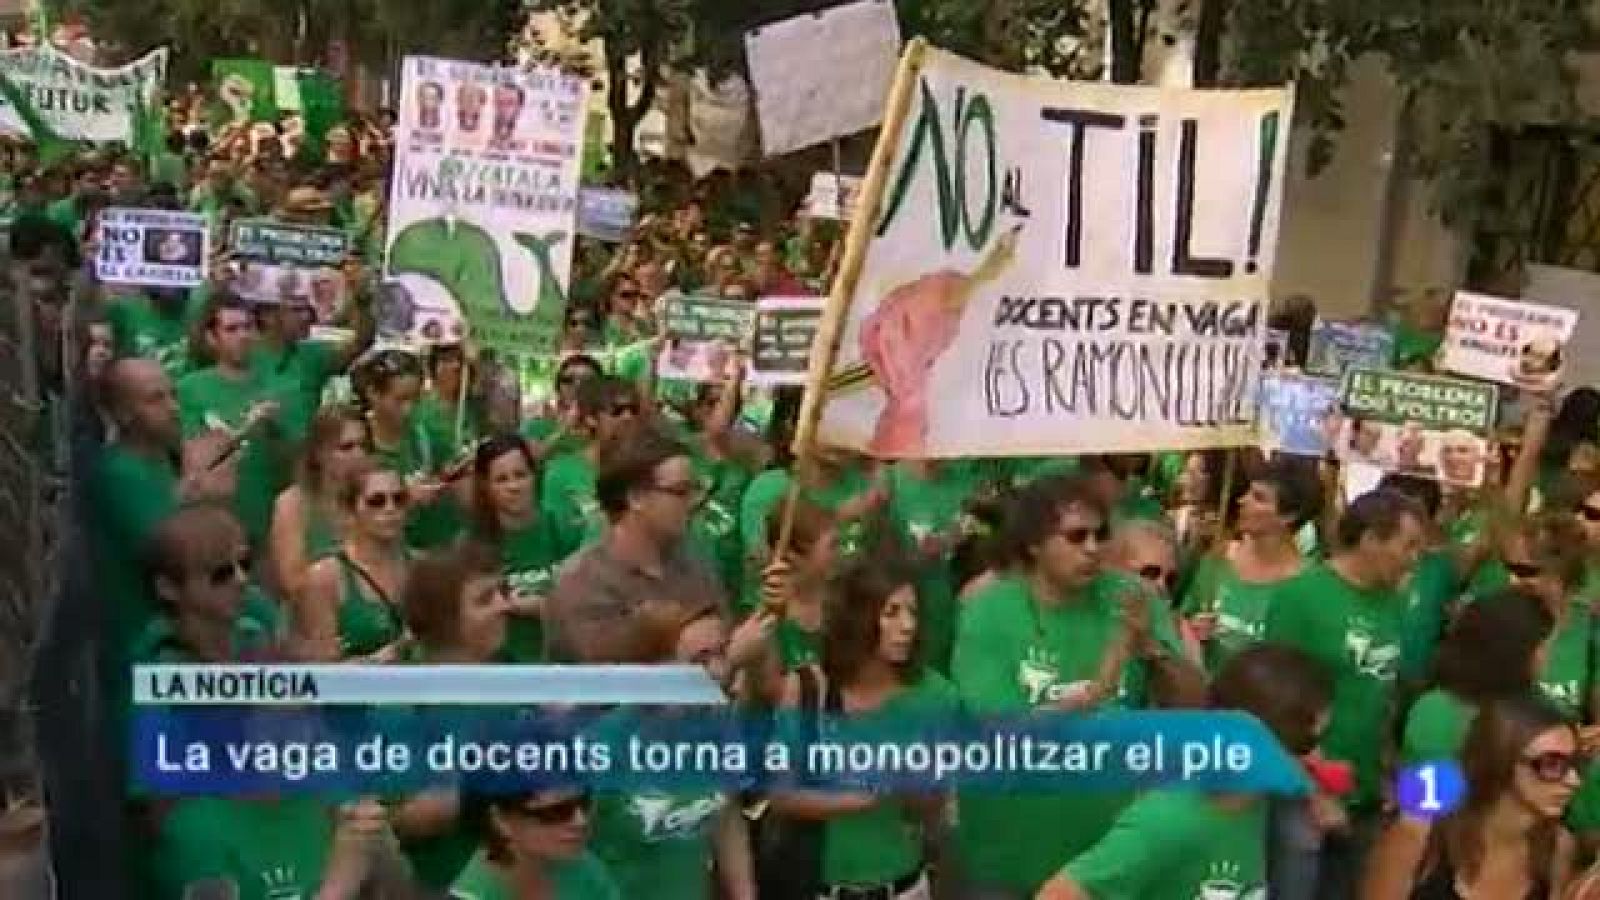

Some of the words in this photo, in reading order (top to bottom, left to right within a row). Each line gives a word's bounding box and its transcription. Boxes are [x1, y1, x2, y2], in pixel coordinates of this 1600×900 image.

[875, 76, 996, 251] NO
[103, 226, 140, 246] NO
[994, 295, 1121, 331] DOCENTS
[1127, 300, 1177, 335] EN
[1182, 301, 1258, 337] VAGA
[1450, 315, 1488, 335] NO
[1042, 337, 1175, 422] RAMON
[1353, 373, 1374, 391] EL
[1380, 378, 1487, 407] PROBLEMA
